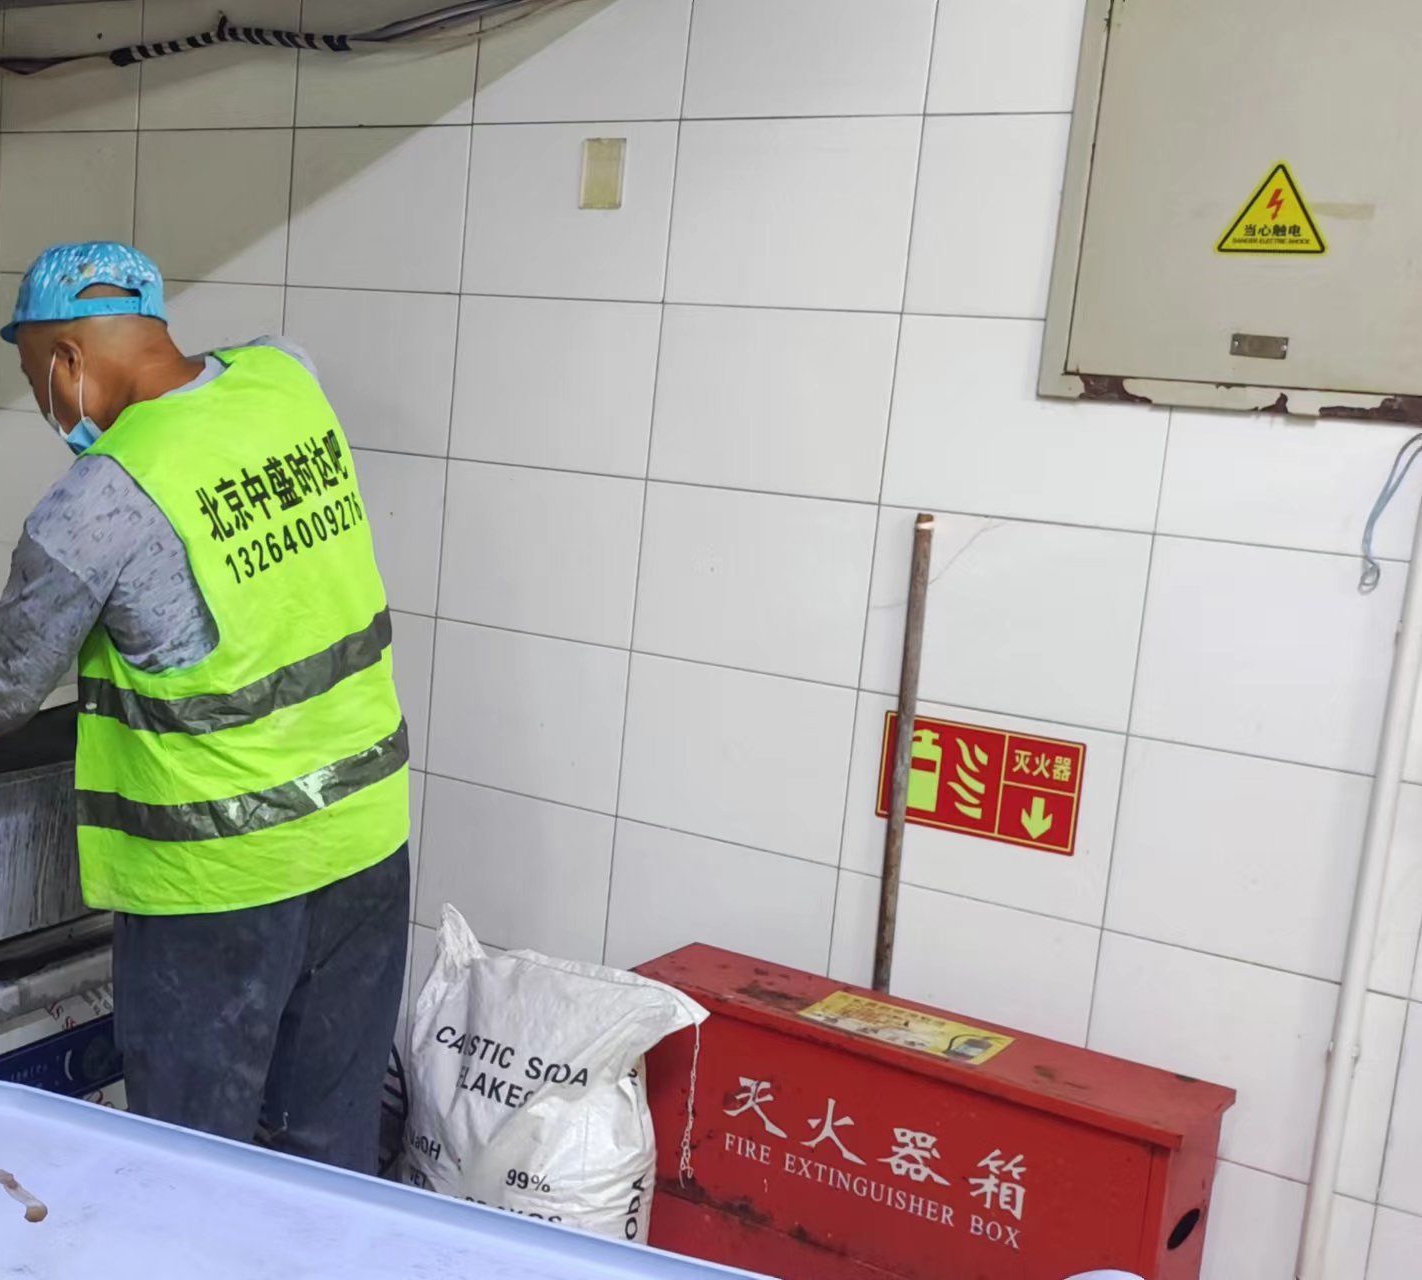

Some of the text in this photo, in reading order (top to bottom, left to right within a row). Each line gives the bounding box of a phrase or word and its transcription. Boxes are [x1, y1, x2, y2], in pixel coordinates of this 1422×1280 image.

[1243, 223, 1302, 237] 当心触电
[225, 491, 363, 584] 13264009276
[1011, 748, 1072, 782] 灭火器
[436, 1026, 515, 1069] CASTIC
[525, 1056, 588, 1087] SODA
[722, 1076, 1027, 1221] 灭火器箱
[505, 1168, 551, 1193] 99%
[725, 1133, 1021, 1249] FIRE EXTINGUISHER BOX
